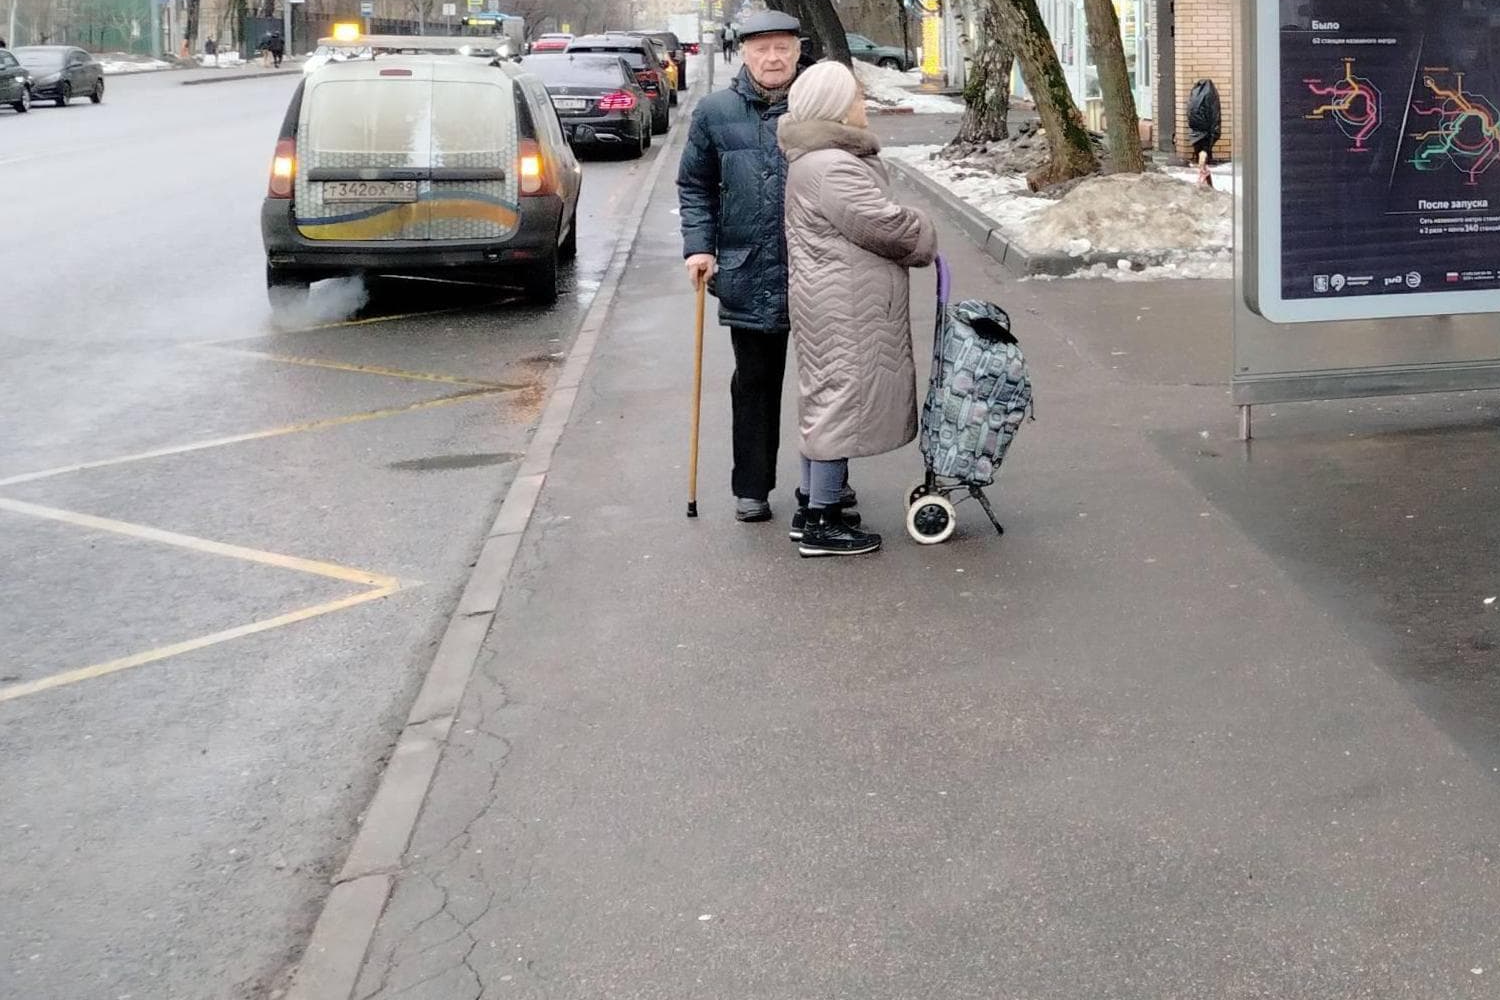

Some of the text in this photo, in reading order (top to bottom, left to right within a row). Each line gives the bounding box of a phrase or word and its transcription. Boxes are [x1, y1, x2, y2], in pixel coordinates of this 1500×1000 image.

[1311, 20, 1340, 30] Было
[1418, 200, 1489, 210] После запуска
